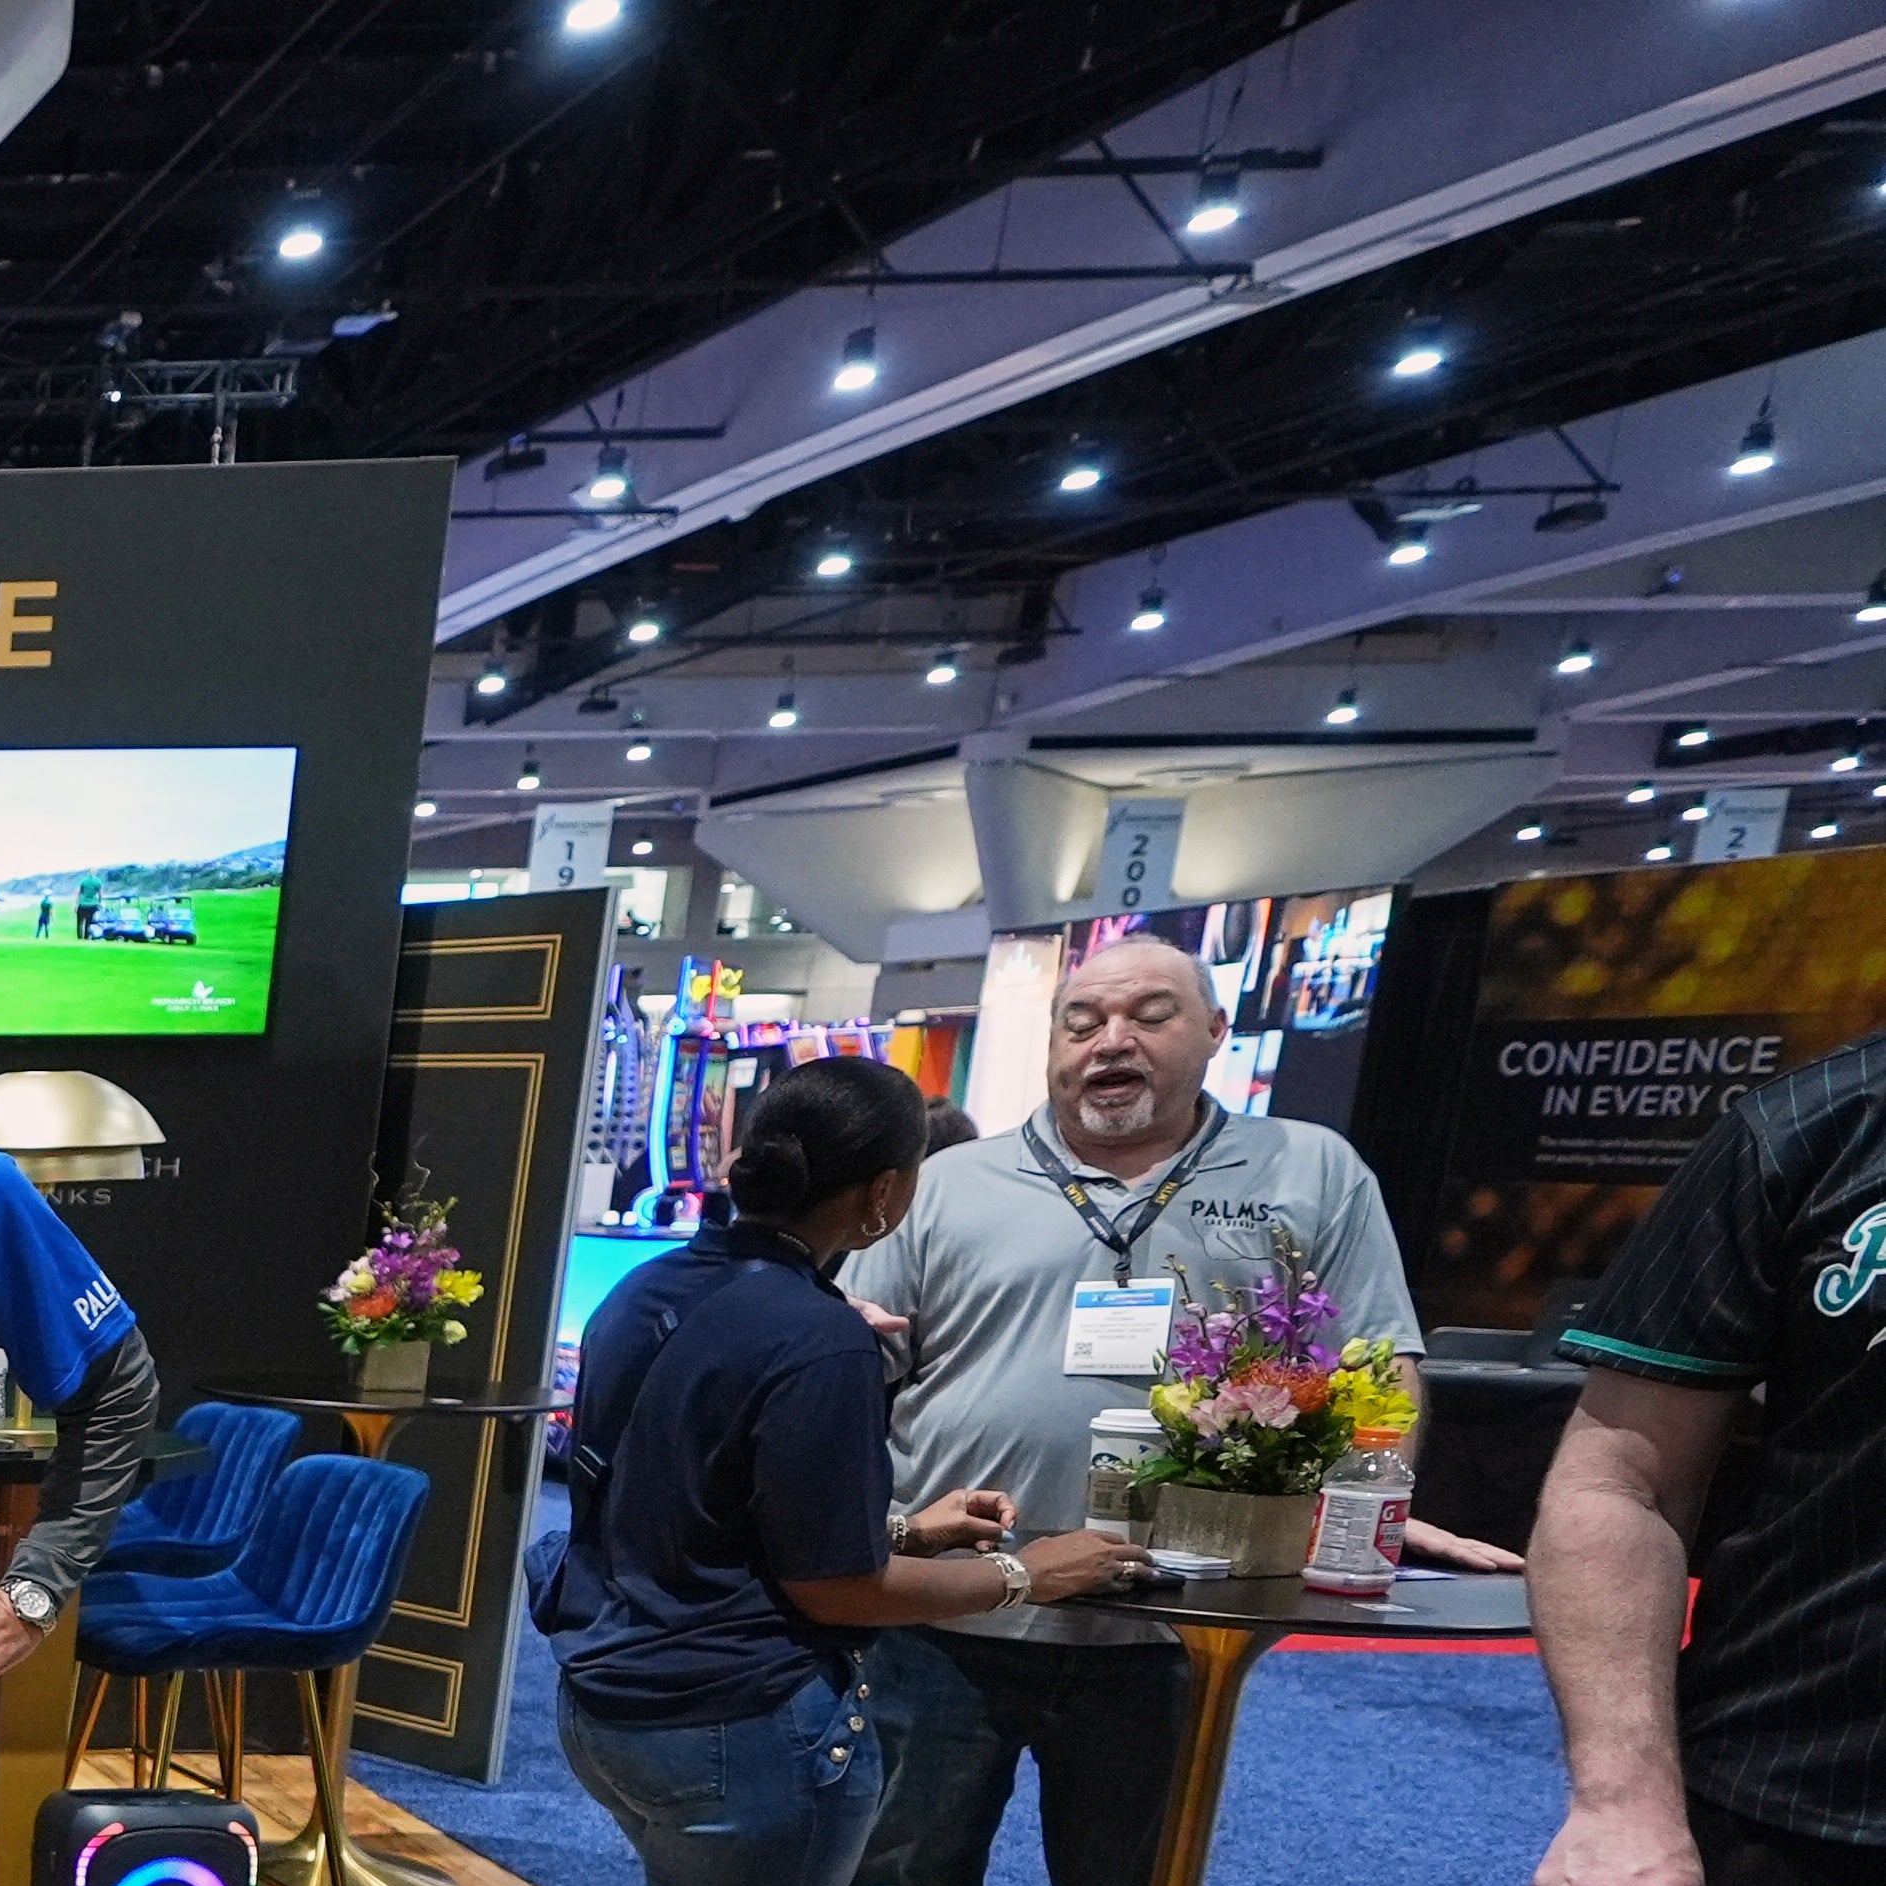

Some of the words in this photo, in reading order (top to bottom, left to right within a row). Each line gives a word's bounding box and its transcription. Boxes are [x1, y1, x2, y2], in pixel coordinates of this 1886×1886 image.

[1498, 1035, 1783, 1077] CONFIDENCE
[1540, 1085, 1582, 1116] IN
[1587, 1084, 1714, 1117] EVERY
[1190, 1198, 1270, 1225] PALMS
